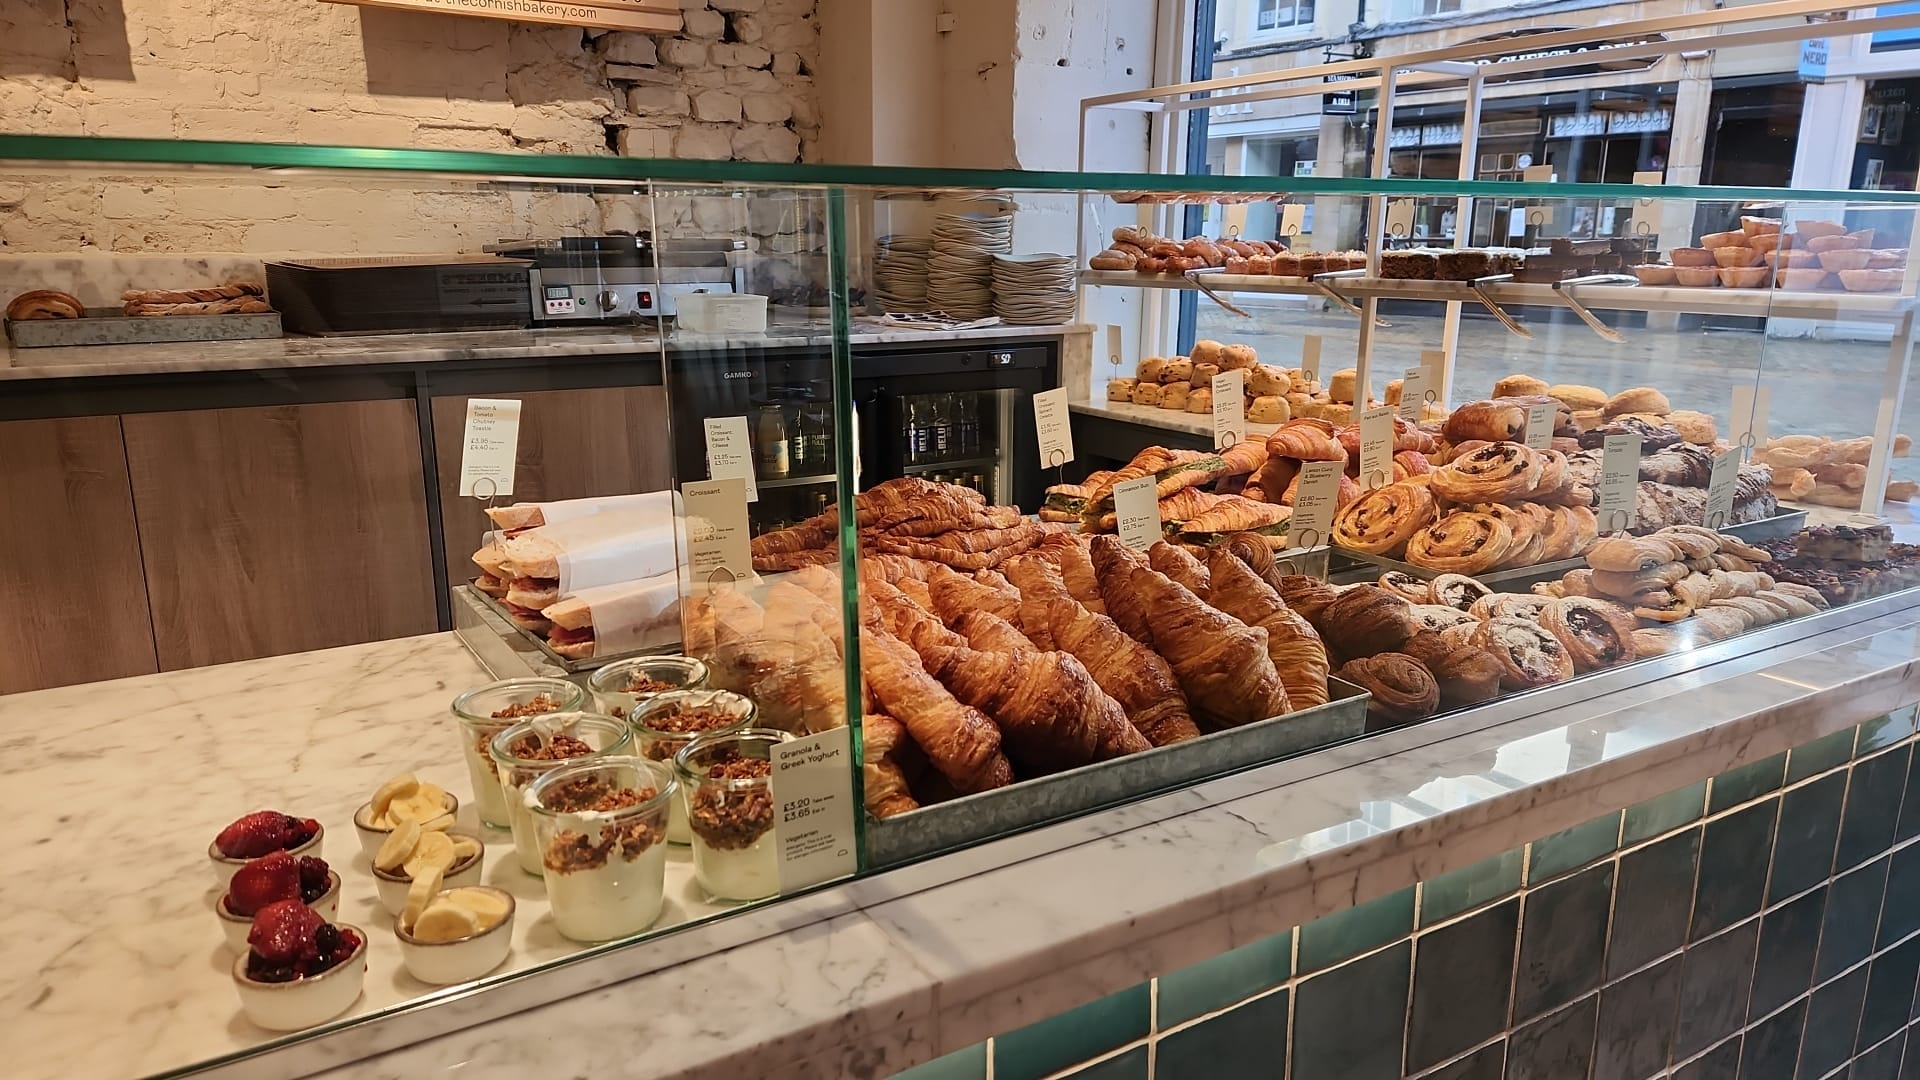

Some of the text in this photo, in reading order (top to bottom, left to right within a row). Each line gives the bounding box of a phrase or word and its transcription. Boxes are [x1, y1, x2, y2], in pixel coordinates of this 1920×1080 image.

[1803, 51, 1828, 65] NERO
[723, 371, 752, 380] GAMKO
[918, 429, 928, 452] BELU
[937, 427, 947, 450] BELU
[689, 488, 721, 497] Croissant
[780, 742, 821, 760] Granola &
[780, 749, 840, 771] Greek Yoghurt
[783, 797, 810, 813] £3.20
[784, 807, 811, 823] £3.65
[785, 829, 819, 844] Vegetarian
